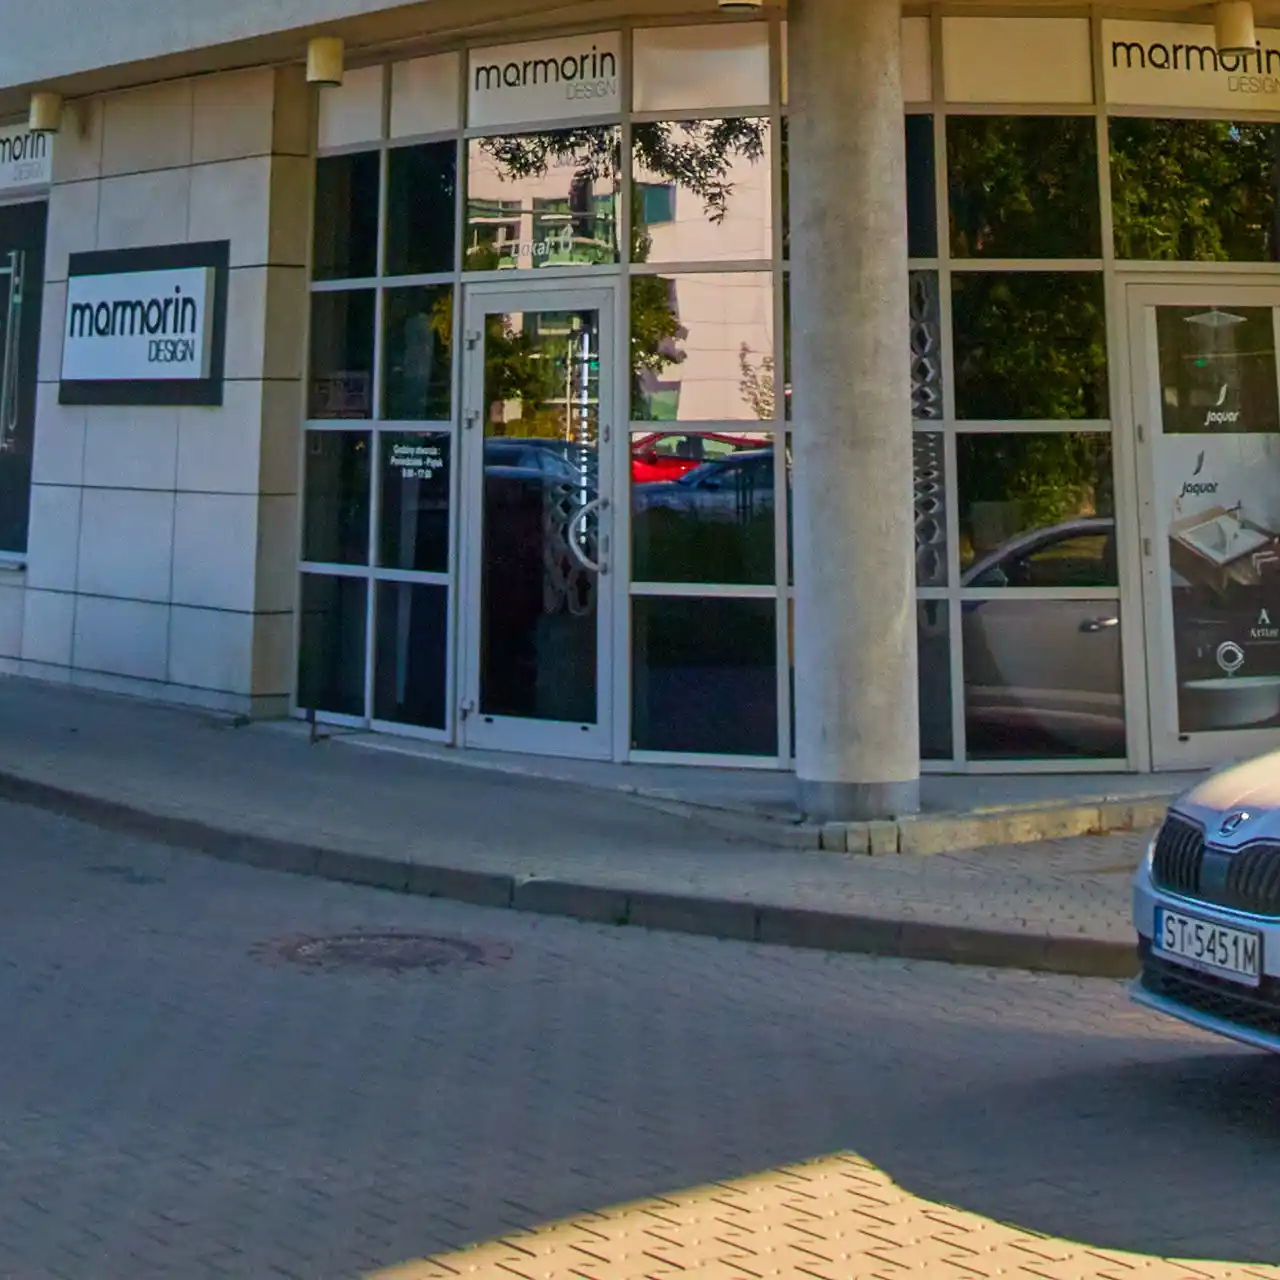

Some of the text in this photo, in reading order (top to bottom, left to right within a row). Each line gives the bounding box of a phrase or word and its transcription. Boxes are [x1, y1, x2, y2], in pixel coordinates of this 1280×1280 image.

[474, 44, 617, 91] marmorin
[565, 81, 618, 101] DESIGN
[69, 284, 198, 338] marmorin
[147, 338, 195, 363] DESIGN
[1165, 914, 1257, 973] ST 5451M
